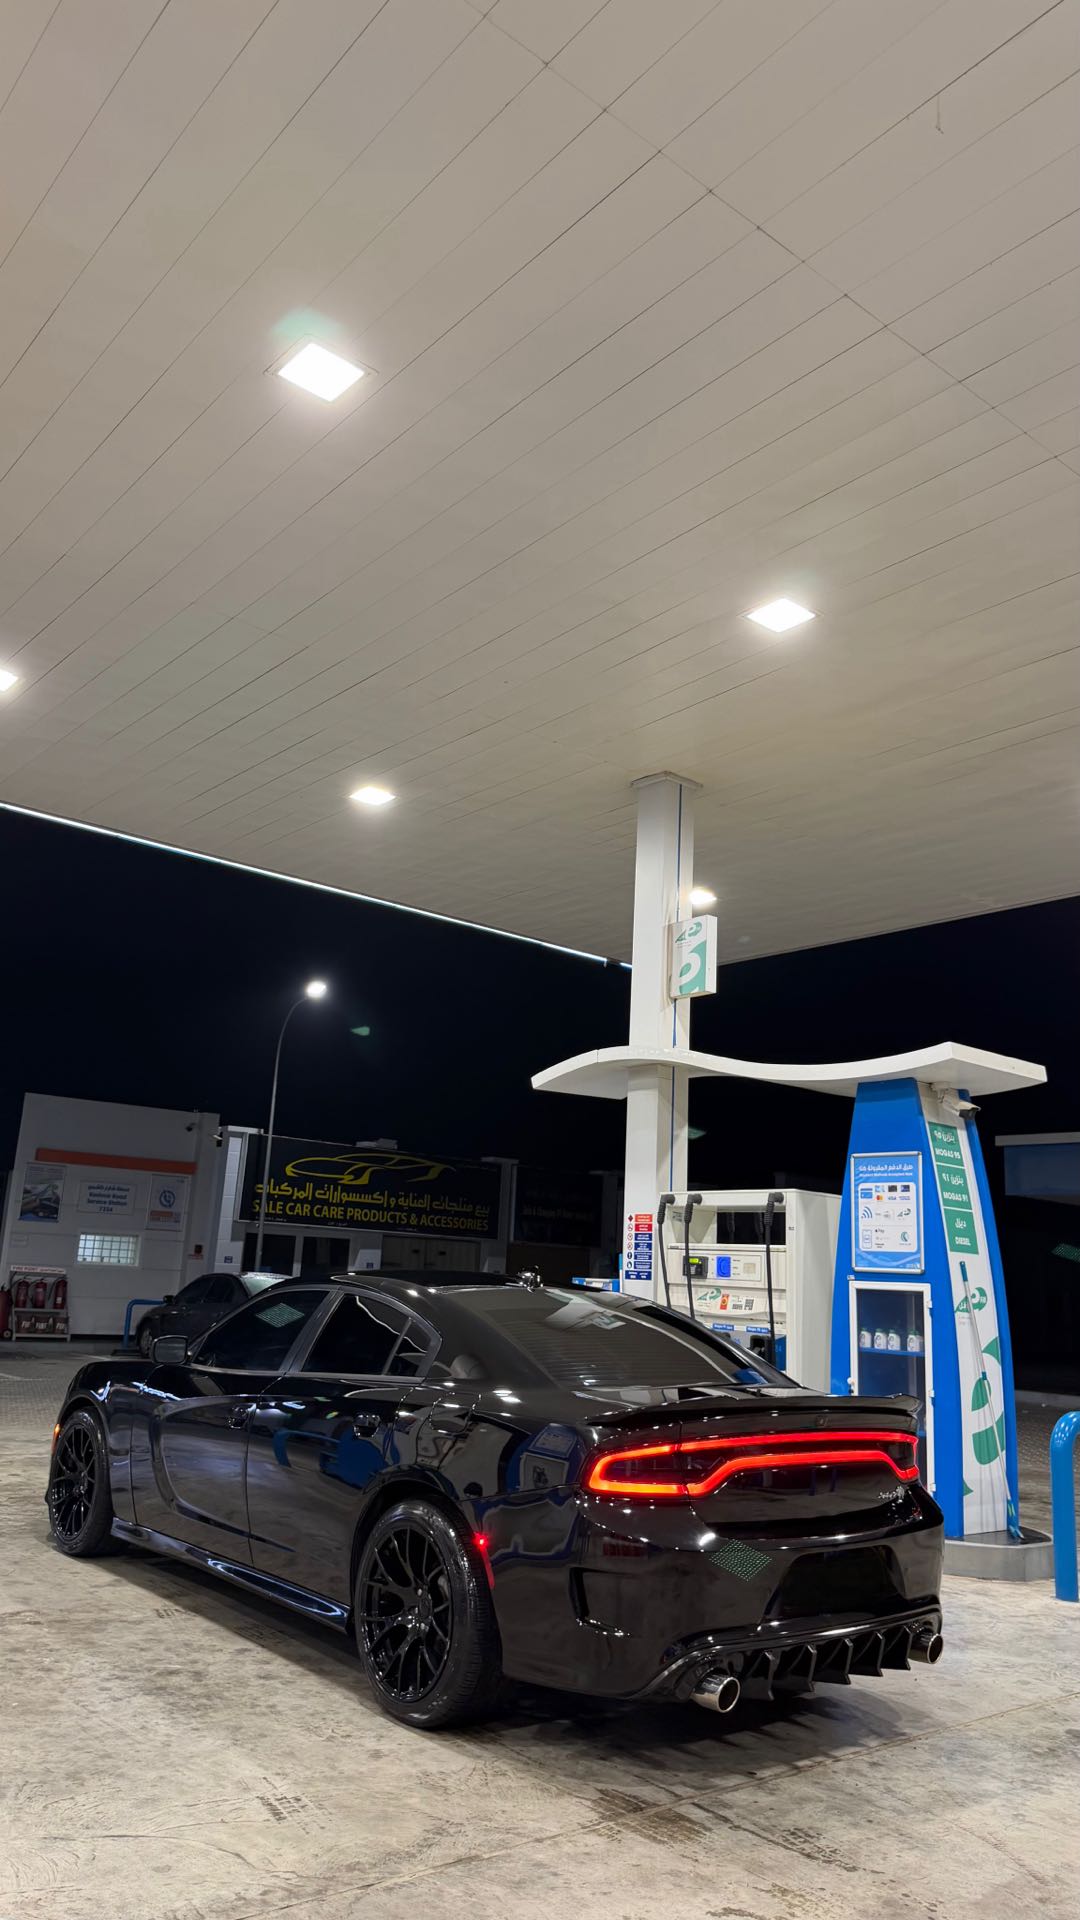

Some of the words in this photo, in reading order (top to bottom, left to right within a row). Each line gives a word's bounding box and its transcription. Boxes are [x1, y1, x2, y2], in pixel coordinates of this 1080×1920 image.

[935, 1147, 953, 1158] MOGAS
[953, 1150, 961, 1159] 95
[398, 1192, 431, 1211] العناية
[943, 1191, 962, 1201] MOGAS
[286, 1202, 311, 1217] CAR
[313, 1204, 345, 1220] CARE
[346, 1207, 408, 1225] PRODUCTS
[409, 1213, 418, 1226] &
[420, 1214, 489, 1231] ACCESSORIES
